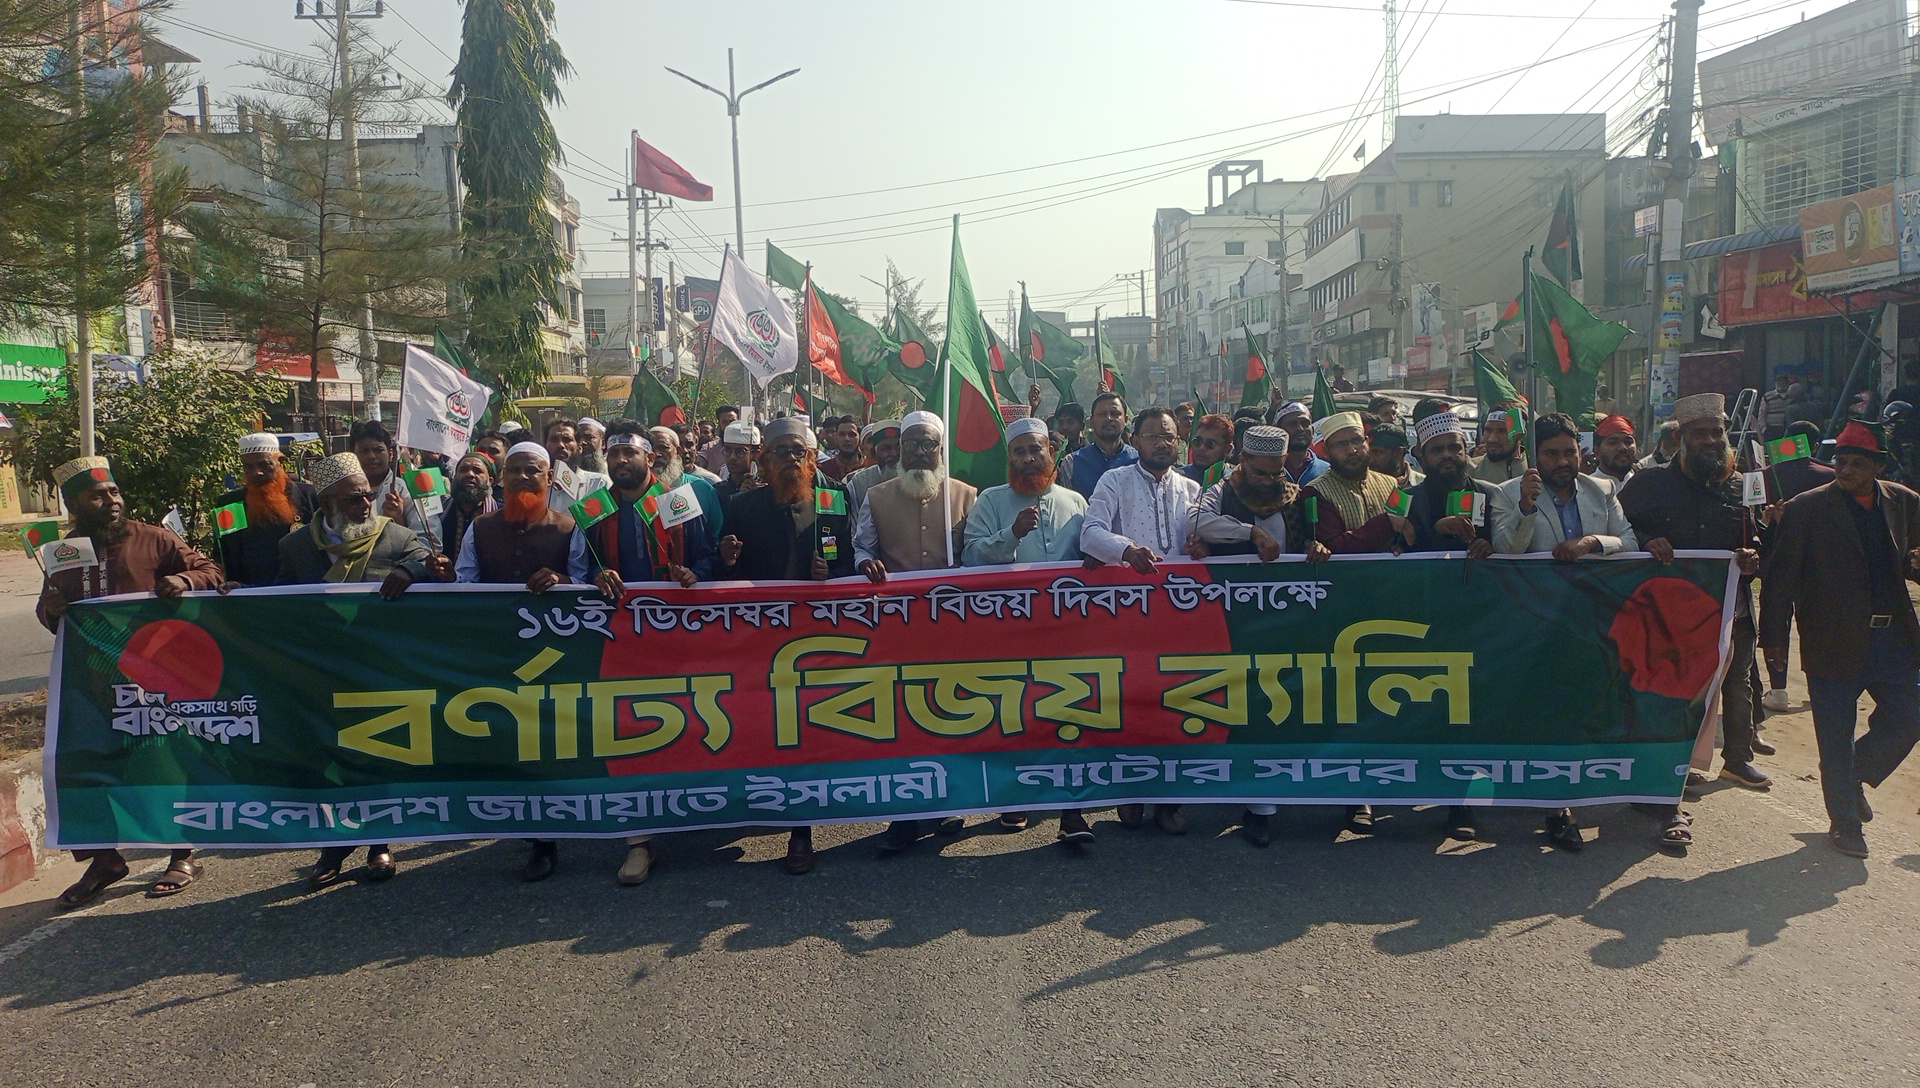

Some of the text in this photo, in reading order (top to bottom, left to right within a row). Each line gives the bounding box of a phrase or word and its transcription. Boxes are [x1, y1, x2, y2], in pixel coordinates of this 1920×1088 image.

[692, 305, 710, 316] GPH
[517, 573, 1333, 640] ১৬ই ডিসেম্বর মহান বিজয় দিবস উপলক্ষে
[111, 707, 260, 744] বাংলাদেশ
[168, 695, 258, 715] একসাথে গড়ি
[332, 646, 733, 766] বর্ণাঢ্য
[769, 635, 1125, 747] বিজয়
[173, 754, 1635, 831] বাংলাদেশ জামায়াতে ইসলামী নাটোর সদর আসন
